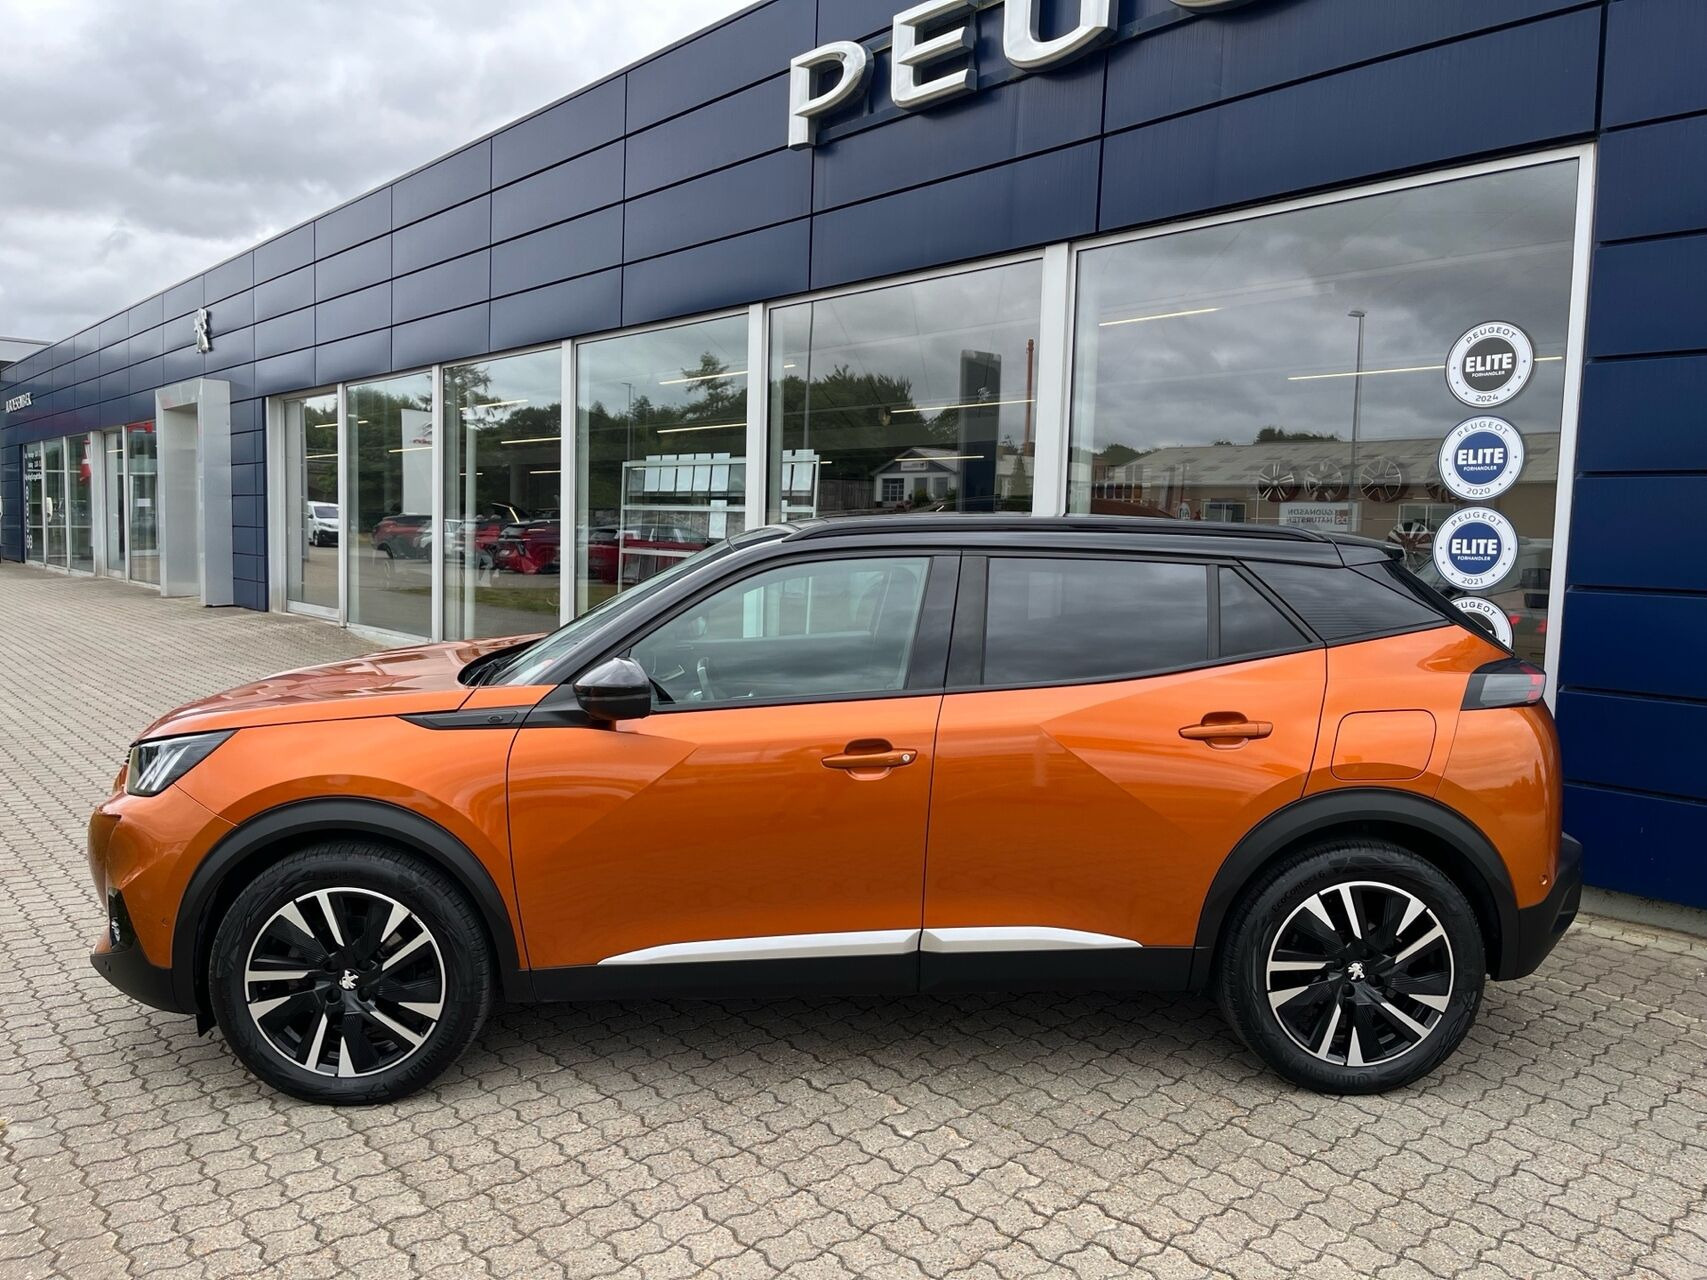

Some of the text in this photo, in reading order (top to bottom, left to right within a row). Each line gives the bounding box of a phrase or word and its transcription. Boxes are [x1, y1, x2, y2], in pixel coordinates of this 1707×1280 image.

[788, 0, 1236, 150] PEU
[1466, 326, 1517, 344] PEUGEOT
[1465, 352, 1513, 372] ELITE
[1475, 394, 1499, 402] 2024
[1457, 421, 1509, 437] PEUGEOT
[1457, 447, 1504, 465] ELITE
[1466, 487, 1491, 495] 2020
[1450, 511, 1503, 527] PEUGEOT
[1451, 538, 1498, 555] ELITE
[1461, 577, 1484, 585] 2021
[1456, 601, 1497, 616] UGEOT
